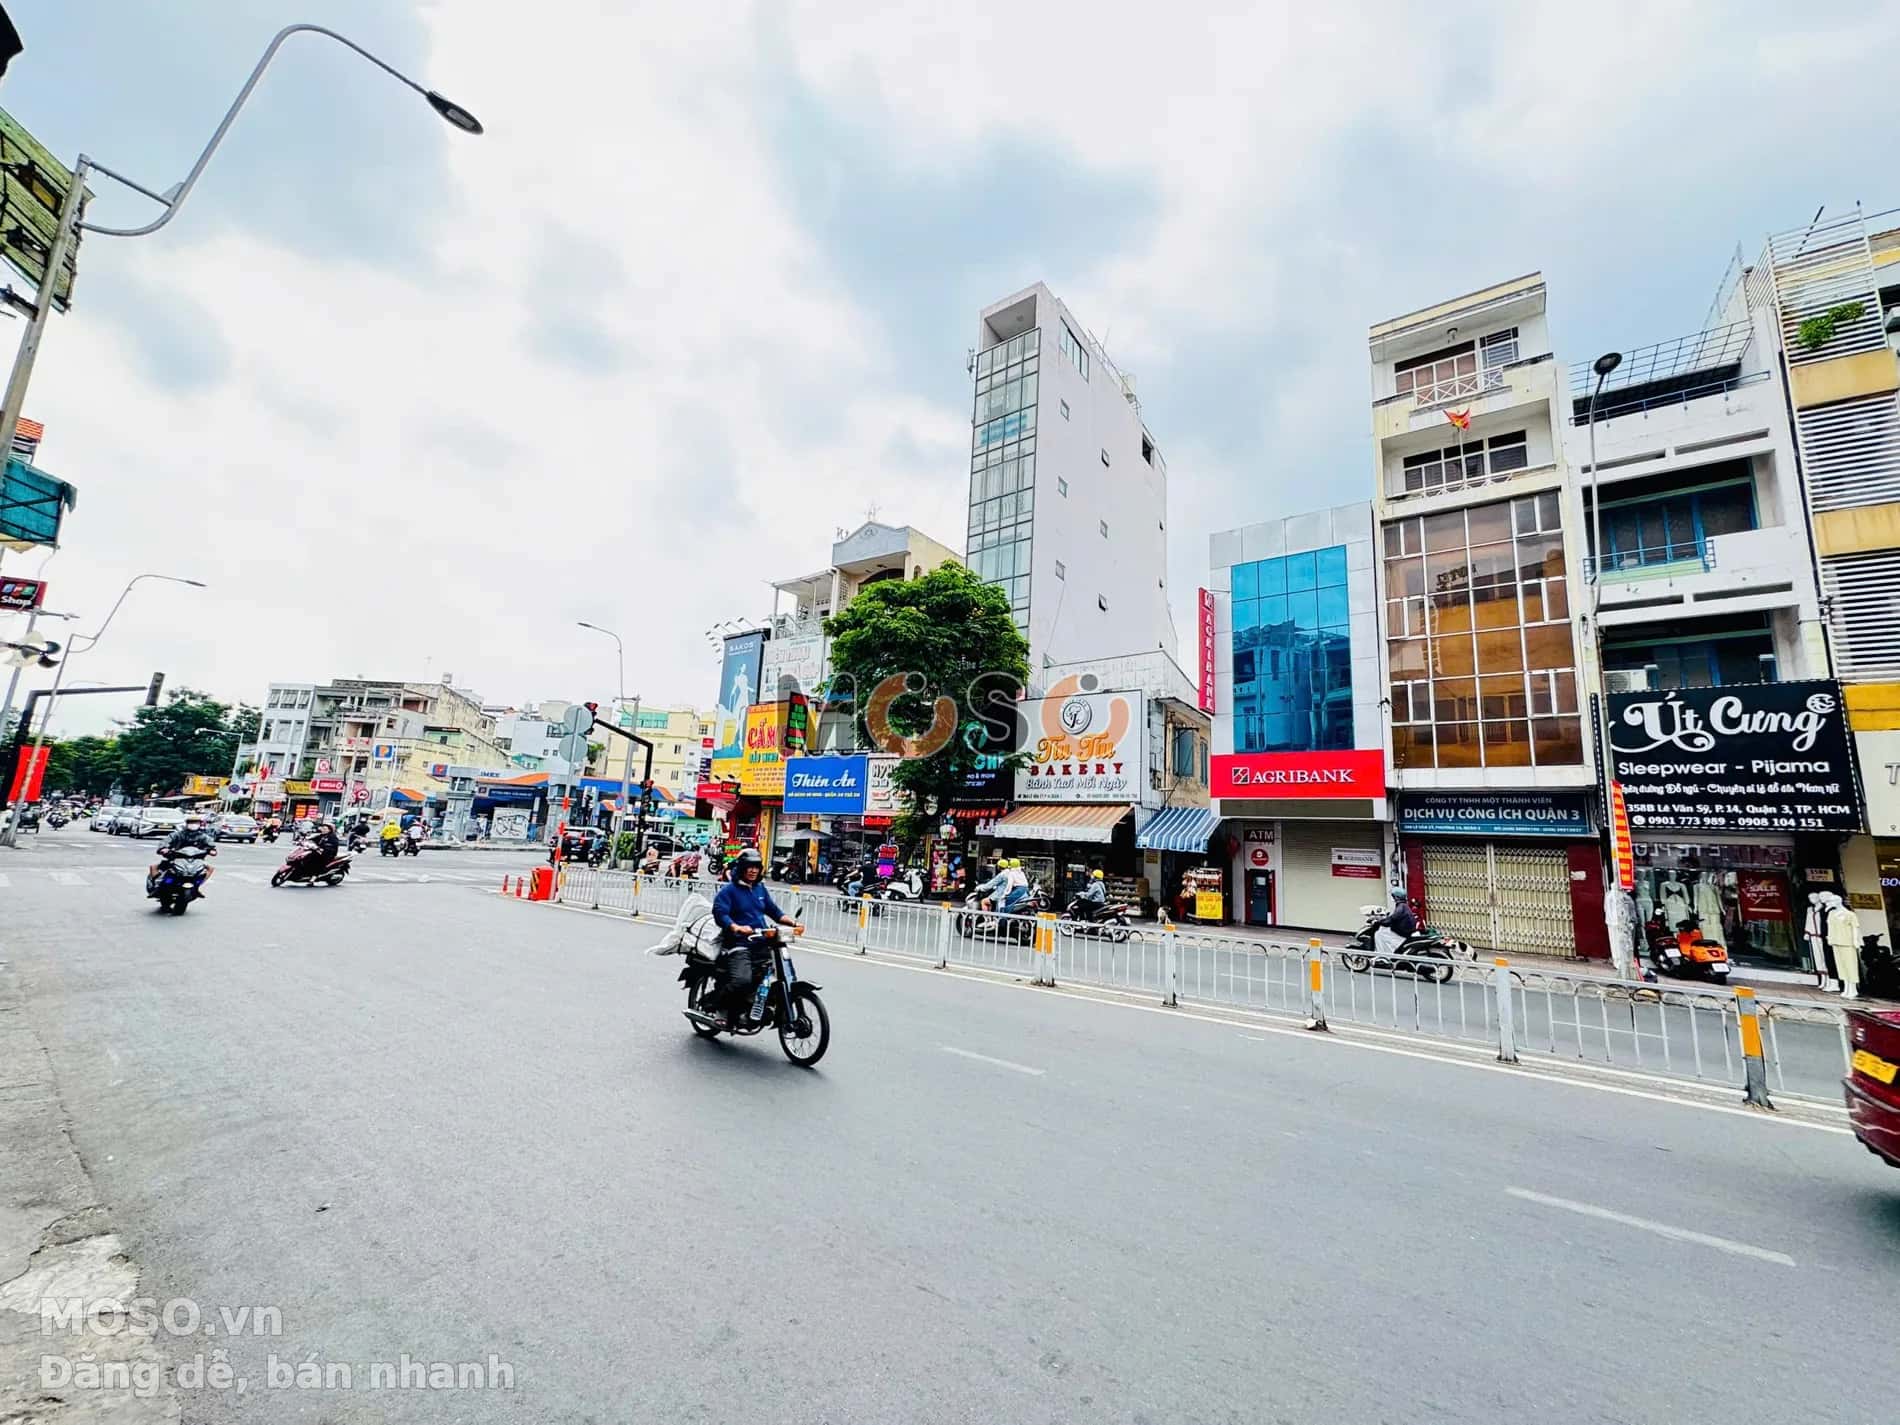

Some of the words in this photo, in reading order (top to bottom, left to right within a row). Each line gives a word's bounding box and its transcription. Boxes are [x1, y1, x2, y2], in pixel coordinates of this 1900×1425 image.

[1205, 613, 1214, 711] AGRIBANK
[1612, 691, 1716, 753] Út
[1709, 695, 1827, 752] Cưng
[1031, 763, 1124, 776] BAKERY
[1618, 761, 1727, 777] Sleepwear
[1751, 760, 1831, 777] Pijama
[1251, 769, 1355, 784] AGRIBANK
[1425, 796, 1447, 804] CÔNG
[1482, 797, 1500, 805] MỘT
[1404, 808, 1434, 822] DỊCH
[1436, 808, 1455, 822] VỤ
[1457, 807, 1496, 820] CÔNG
[1498, 806, 1522, 820] ÍCH
[1524, 807, 1567, 823] QUẬN
[1571, 809, 1580, 820] 3
[1627, 804, 1655, 813] 358B
[1657, 804, 1670, 813] Lê
[1672, 804, 1693, 813] Văn
[1746, 805, 1776, 816] Quận
[1781, 805, 1793, 815] 3,
[1818, 805, 1850, 815] HCM
[1648, 816, 1676, 826] 0901
[1679, 816, 1700, 826] 773
[1703, 817, 1726, 826] 989
[1737, 817, 1770, 827] 0908
[1772, 818, 1797, 827] 104
[1800, 818, 1825, 828] 151
[1249, 830, 1275, 841] ATM
